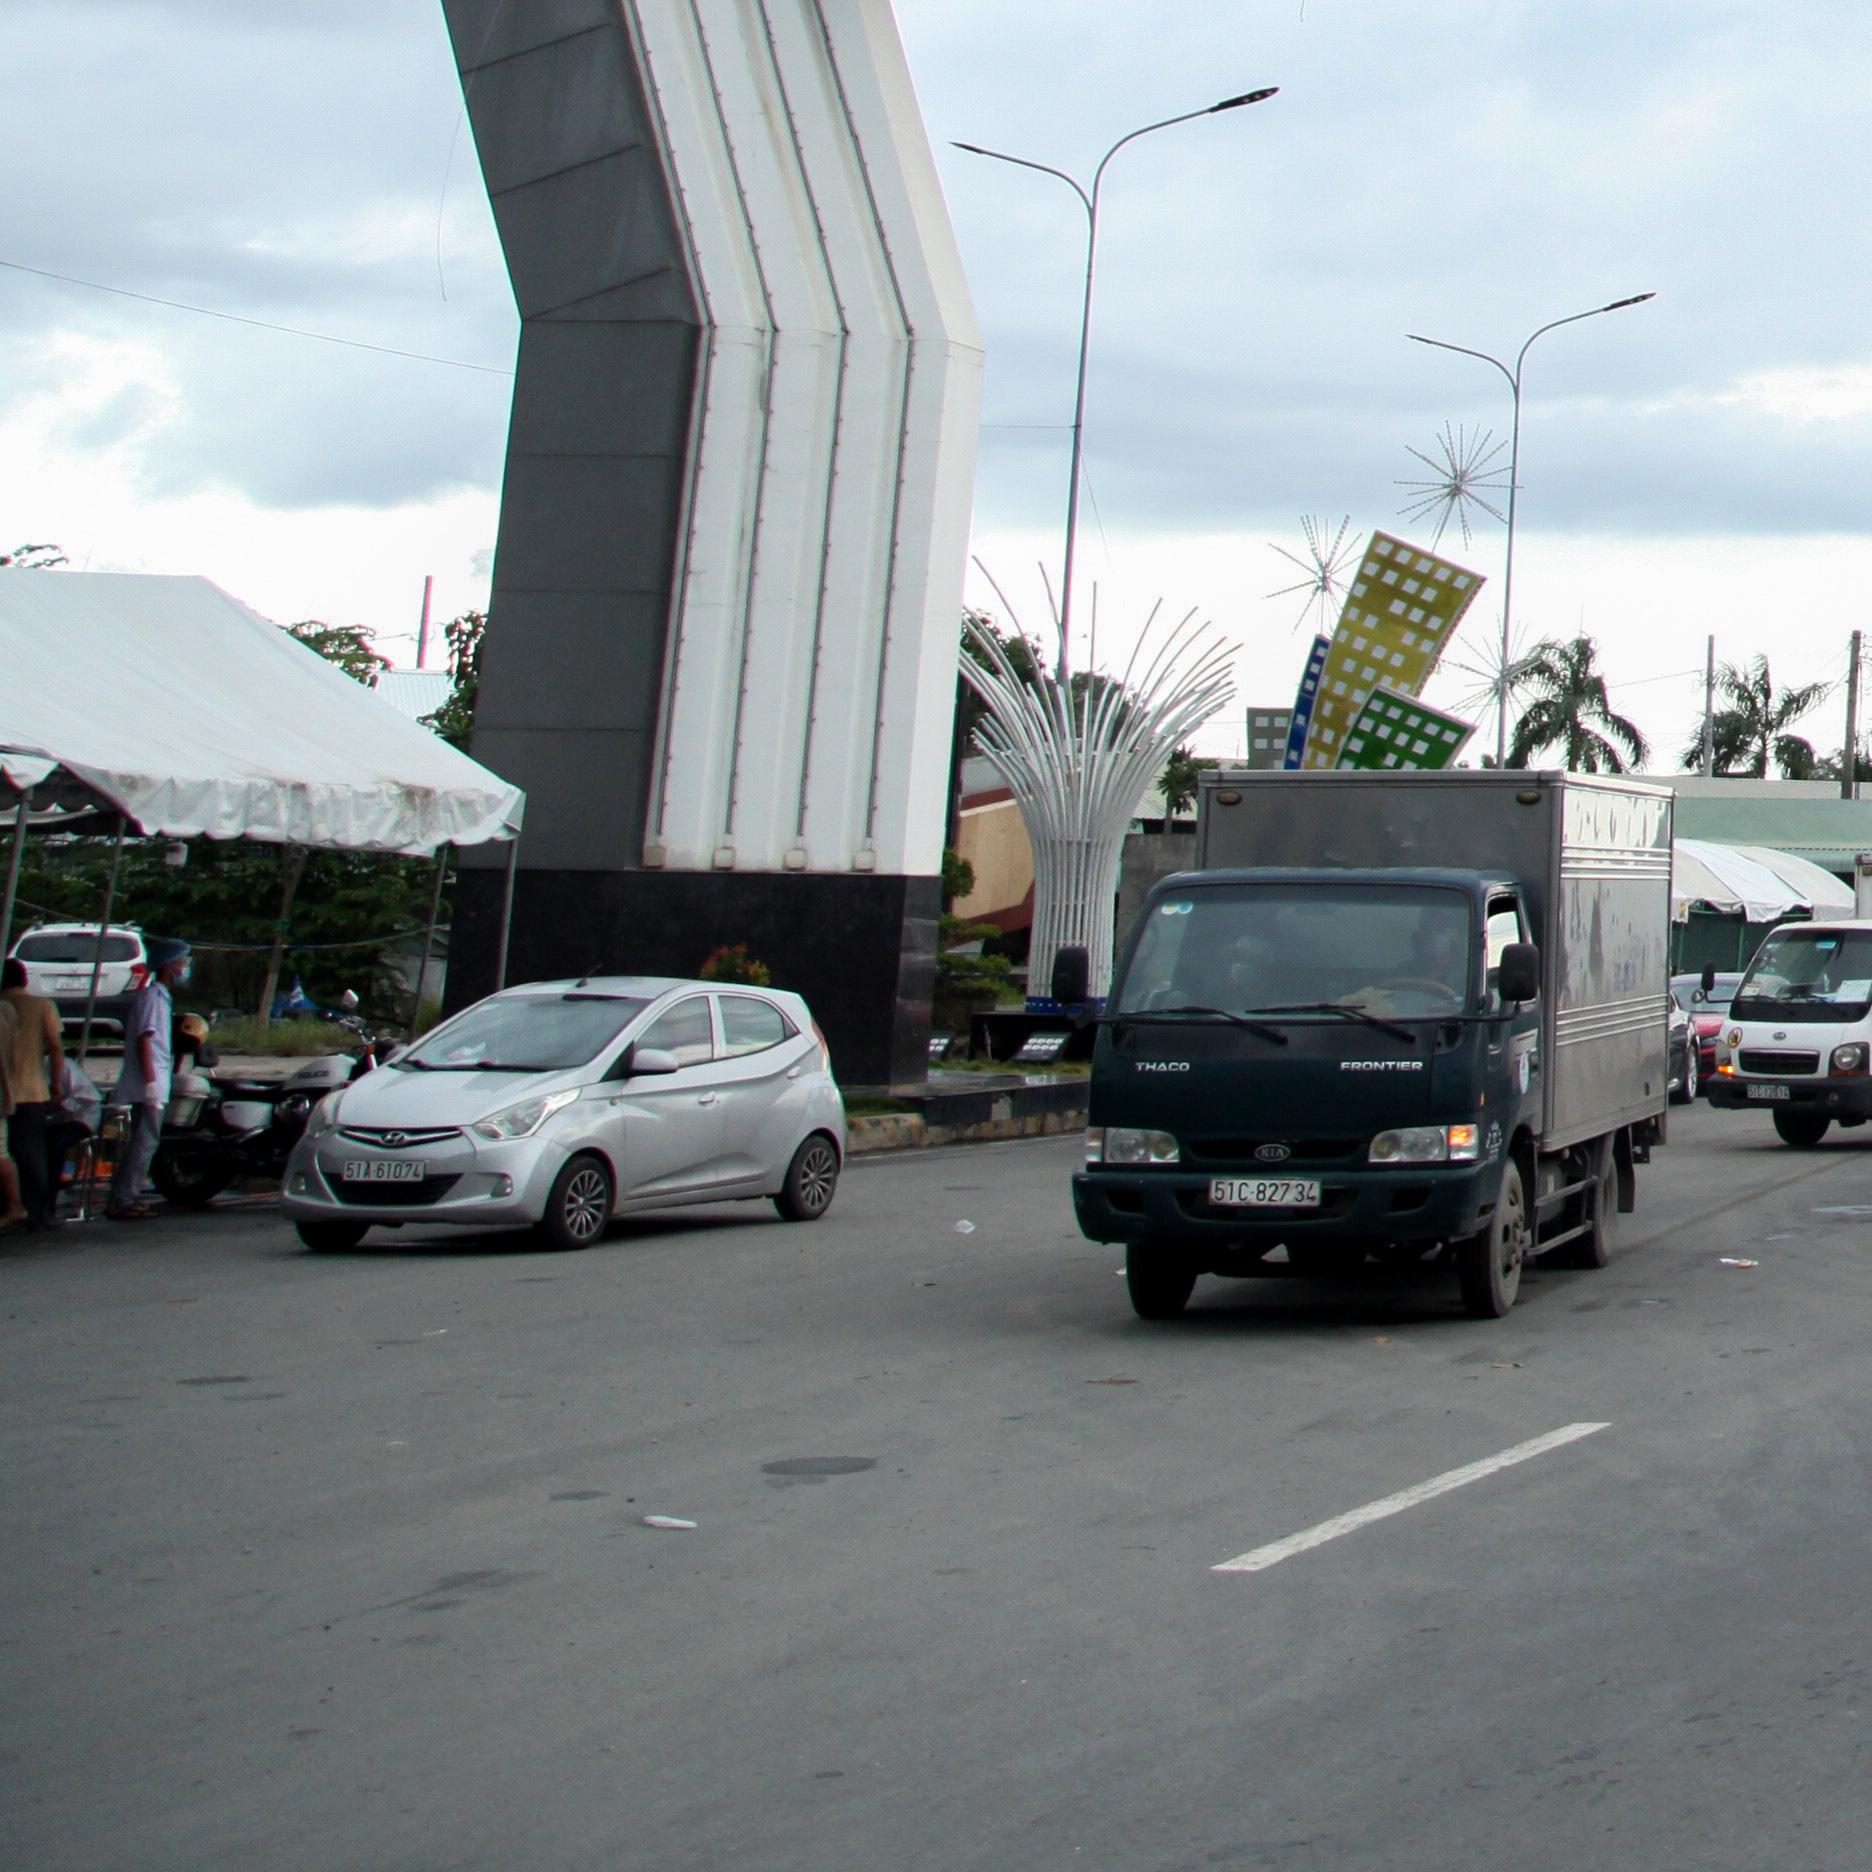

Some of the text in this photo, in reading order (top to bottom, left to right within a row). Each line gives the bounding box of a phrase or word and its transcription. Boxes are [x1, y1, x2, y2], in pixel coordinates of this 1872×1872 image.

[1135, 1061, 1190, 1072] THACO
[1339, 1060, 1424, 1071] FRONTIER
[1262, 1148, 1285, 1158] KIA
